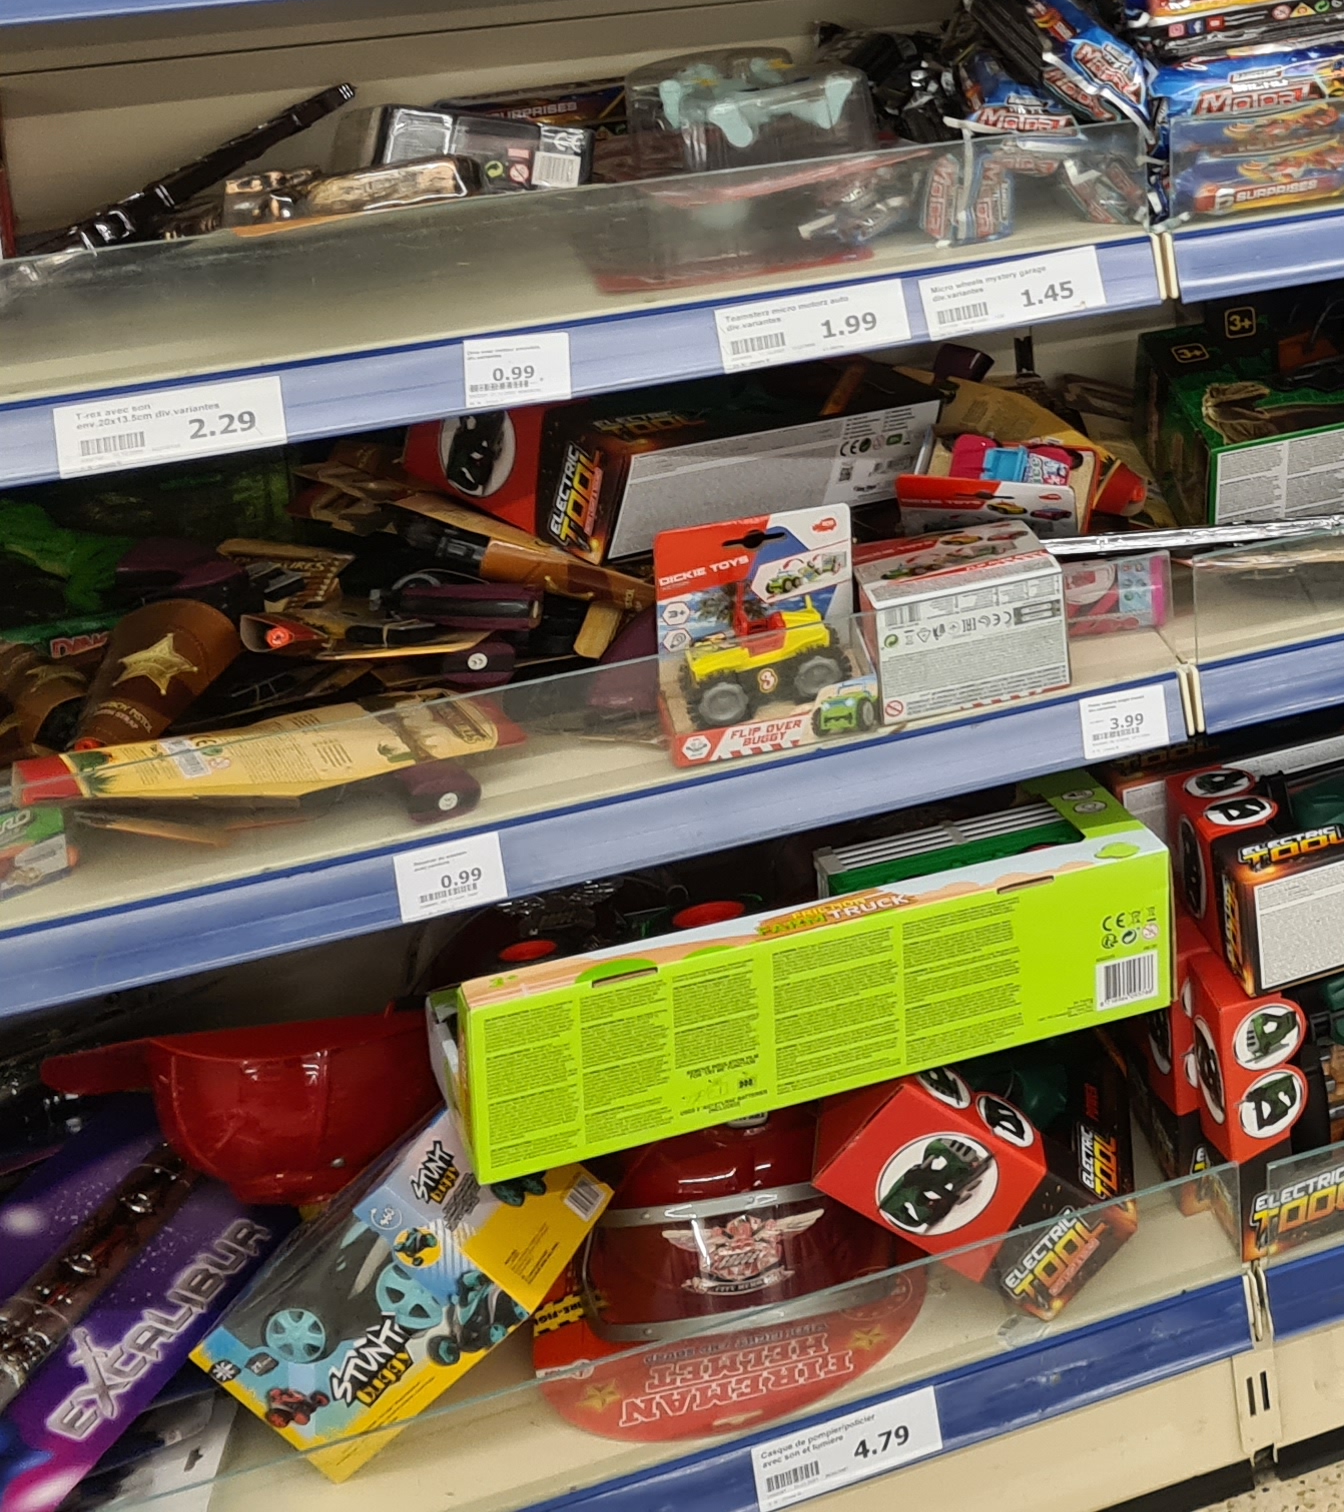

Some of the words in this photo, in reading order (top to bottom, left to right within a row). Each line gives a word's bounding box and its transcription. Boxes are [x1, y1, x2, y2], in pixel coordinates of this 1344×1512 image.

[1236, 178, 1319, 203] SURPRISES
[1020, 280, 1074, 308] 1.45
[821, 312, 877, 339] 1.99
[491, 365, 536, 382] 0.99
[188, 410, 256, 440] 2.29
[550, 443, 580, 534] ELECTRIC
[560, 451, 600, 550] TOOL
[658, 567, 707, 587] DICKIE
[709, 555, 749, 573] TOYS
[731, 727, 761, 740] FLIP
[761, 720, 803, 734] OVER
[1109, 712, 1145, 730] 3.99
[742, 731, 787, 747] BUGGY
[1241, 824, 1341, 854] ELECTRIC
[441, 867, 483, 889] 0.99
[831, 893, 909, 919] TRUCK
[411, 1141, 455, 1202] STUNT
[1005, 1207, 1081, 1288] ELECTRIC
[1013, 1223, 1107, 1300] TOOL
[45, 1217, 271, 1440] EXCALIBUR
[330, 1314, 410, 1405] STUNT
[645, 1332, 831, 1394] HELMET
[619, 1350, 856, 1427] FIREMAN
[760, 1443, 794, 1461] Casque
[795, 1438, 806, 1448] de
[853, 1425, 910, 1460] 4.79
[762, 1458, 783, 1469] avec
[784, 1452, 801, 1462] son
